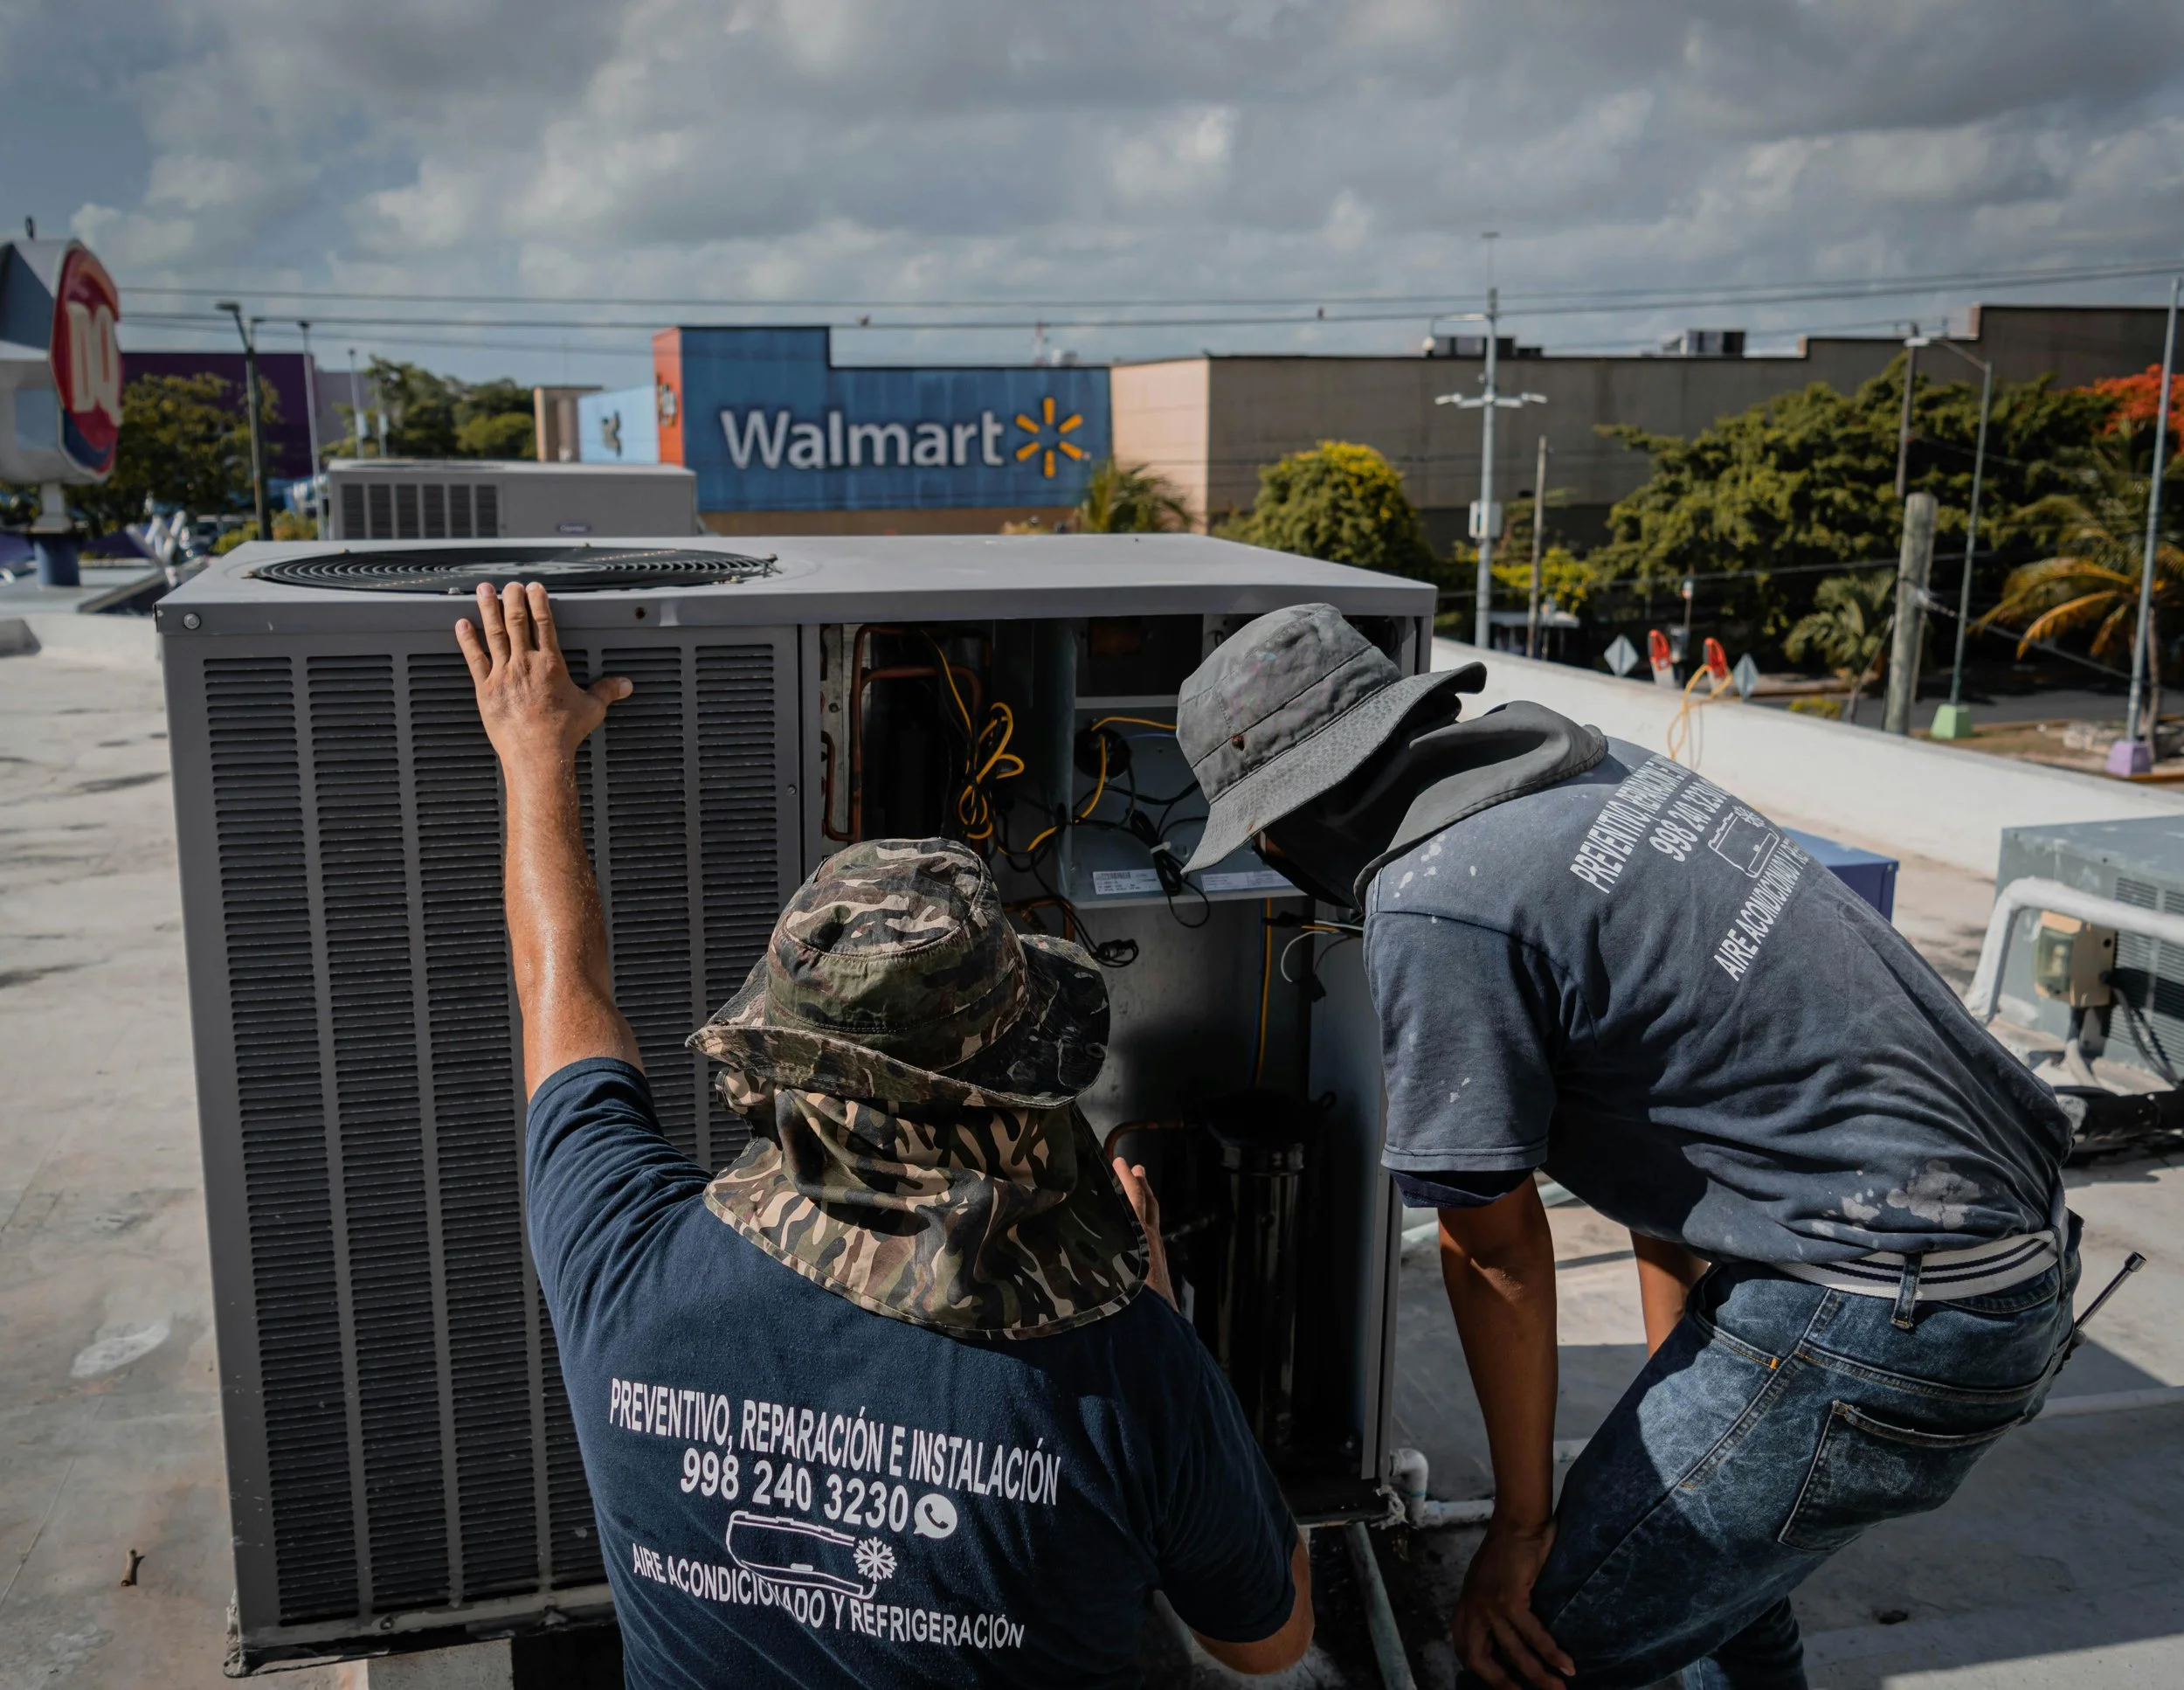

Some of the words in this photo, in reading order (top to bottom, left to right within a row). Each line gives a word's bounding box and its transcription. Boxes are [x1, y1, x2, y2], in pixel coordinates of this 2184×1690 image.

[66, 301, 123, 427] DQ
[720, 411, 1004, 469] Walmart
[1667, 800, 1711, 832] 240
[1680, 781, 1727, 814] 3230
[1570, 800, 1661, 894] PREVENTIVO,
[1648, 819, 1697, 862] 998
[1735, 854, 1800, 944] ACONDICIONADO
[1714, 929, 1759, 981] AIRE
[610, 1378, 732, 1455] PREVENTIVO,
[740, 1399, 884, 1473] REPARACIÓN
[889, 1425, 905, 1477] E
[909, 1430, 1061, 1506] INSTALACIÓN
[681, 1448, 739, 1500] 998
[752, 1460, 812, 1511] 240
[824, 1474, 909, 1532] 3230
[632, 1543, 667, 1583] AIRE
[832, 1592, 845, 1630] Y
[850, 1598, 1025, 1649] REFRIGERACIÓN
